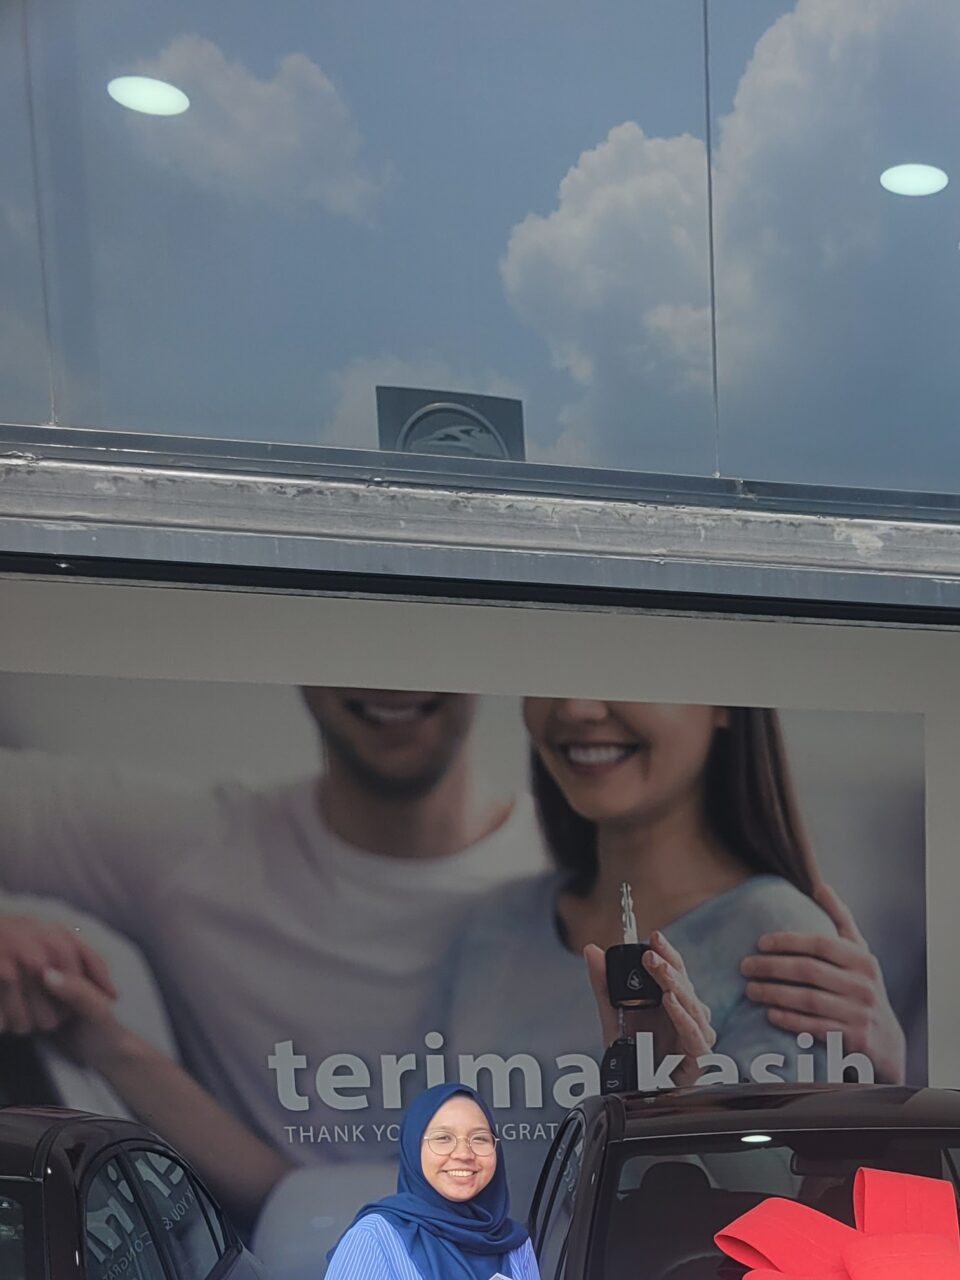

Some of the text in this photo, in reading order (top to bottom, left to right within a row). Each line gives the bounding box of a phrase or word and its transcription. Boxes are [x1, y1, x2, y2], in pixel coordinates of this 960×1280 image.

[267, 1031, 875, 1111] terima kasih
[284, 1124, 400, 1143] THANK YO
